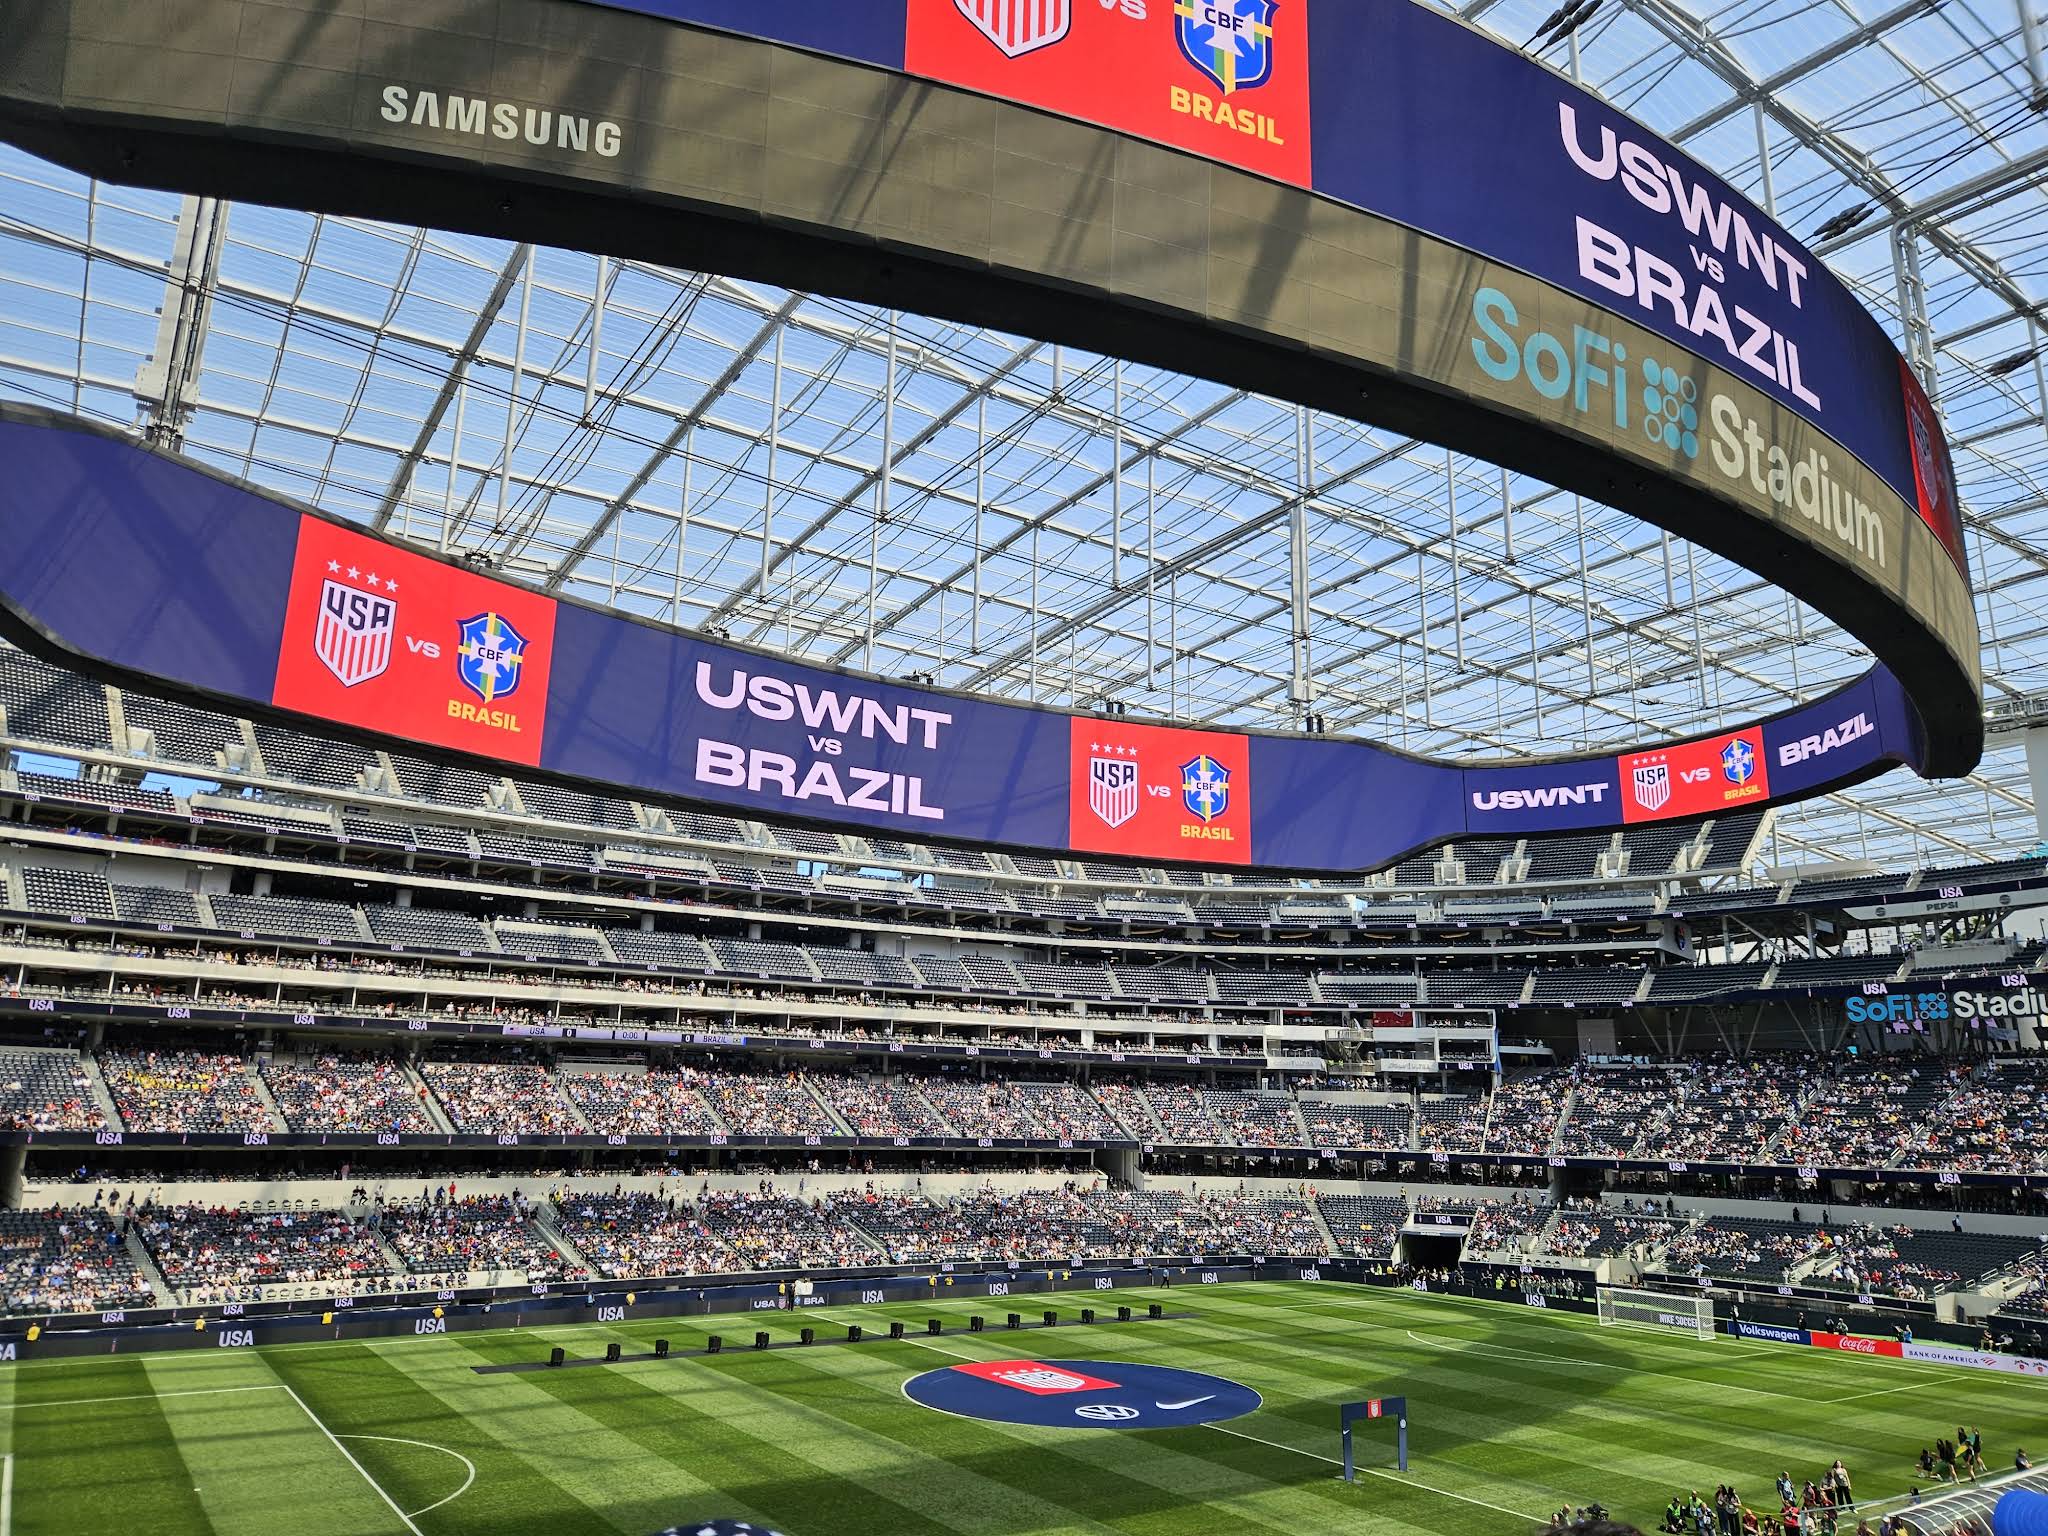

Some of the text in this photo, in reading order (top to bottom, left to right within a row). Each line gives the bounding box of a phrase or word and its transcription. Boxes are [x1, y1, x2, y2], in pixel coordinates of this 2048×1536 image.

[1204, 8, 1244, 32] CBF
[1170, 85, 1284, 145] BRASIL
[380, 85, 622, 157] SAMSUNG
[1559, 102, 1807, 309] USWNT
[1575, 215, 1822, 412] BRAZIL
[1471, 287, 1887, 568] SoFi Stadium
[327, 586, 390, 631] USA
[478, 646, 504, 662] CBF
[695, 661, 952, 750] USWNT
[448, 700, 521, 732] BRASIL
[1778, 712, 1874, 767] BRAZIL
[695, 738, 944, 820] BRAZIL
[1094, 762, 1134, 788] USA
[1635, 768, 1666, 785] USA
[1196, 782, 1215, 791] CBF
[25, 794, 40, 802] USA
[1472, 783, 1608, 810] USWNT
[1724, 784, 1761, 801] BRASIL
[1181, 825, 1234, 841] BRASIL
[1939, 887, 1963, 898] USA
[1926, 901, 1959, 911] PEPSI
[70, 916, 86, 924] USA
[158, 924, 173, 932] USA
[241, 931, 255, 939] USA
[2002, 974, 2028, 987] USA
[1863, 983, 1888, 995] USA
[29, 999, 54, 1011] USA
[1846, 994, 1914, 1022] SoFi
[167, 1008, 190, 1019] USA
[294, 1014, 315, 1025] USA
[408, 1020, 427, 1030] USA
[703, 1035, 727, 1043] BRAZIL
[809, 1039, 824, 1049] USA
[889, 1043, 903, 1052] USA
[966, 1047, 979, 1055] USA
[1039, 1050, 1052, 1058] USA
[1112, 1054, 1125, 1062] USA
[1186, 1056, 1200, 1065] USA
[1458, 1062, 1473, 1071] USA
[95, 1132, 122, 1144] USA
[244, 1134, 268, 1145] USA
[377, 1134, 400, 1145] USA
[498, 1134, 518, 1145] USA
[608, 1135, 627, 1145] USA
[709, 1136, 727, 1145] USA
[804, 1136, 821, 1145] USA
[893, 1137, 909, 1146] USA
[978, 1138, 993, 1147] USA
[1059, 1139, 1073, 1148] USA
[1321, 1149, 1337, 1158] USA
[1432, 1153, 1449, 1162] USA
[1548, 1157, 1566, 1166] USA
[1669, 1162, 1688, 1171] USA
[1797, 1167, 1819, 1178] USA
[1939, 1173, 1961, 1184] USA
[1436, 1216, 1452, 1224] USA
[1202, 1273, 1218, 1283] USA
[1301, 1269, 1320, 1280] USA
[1095, 1278, 1112, 1289] USA
[1698, 1278, 1712, 1286] USA
[532, 1285, 548, 1294] USA
[990, 1283, 1008, 1295] USA
[1778, 1287, 1793, 1295] USA
[438, 1291, 455, 1300] USA
[862, 1290, 884, 1303] USA
[1526, 1294, 1546, 1307] USA
[1859, 1296, 1874, 1305] USA
[335, 1298, 353, 1307] USA
[754, 1300, 775, 1308] USA
[223, 1305, 243, 1315] USA
[598, 1307, 624, 1321] USA
[102, 1313, 124, 1323] USA
[1659, 1314, 1674, 1324] NIKE
[415, 1319, 445, 1334] USA
[1739, 1324, 1800, 1341] Volkswagen
[219, 1330, 253, 1347] USA
[1943, 1355, 1978, 1364] AMERICA
